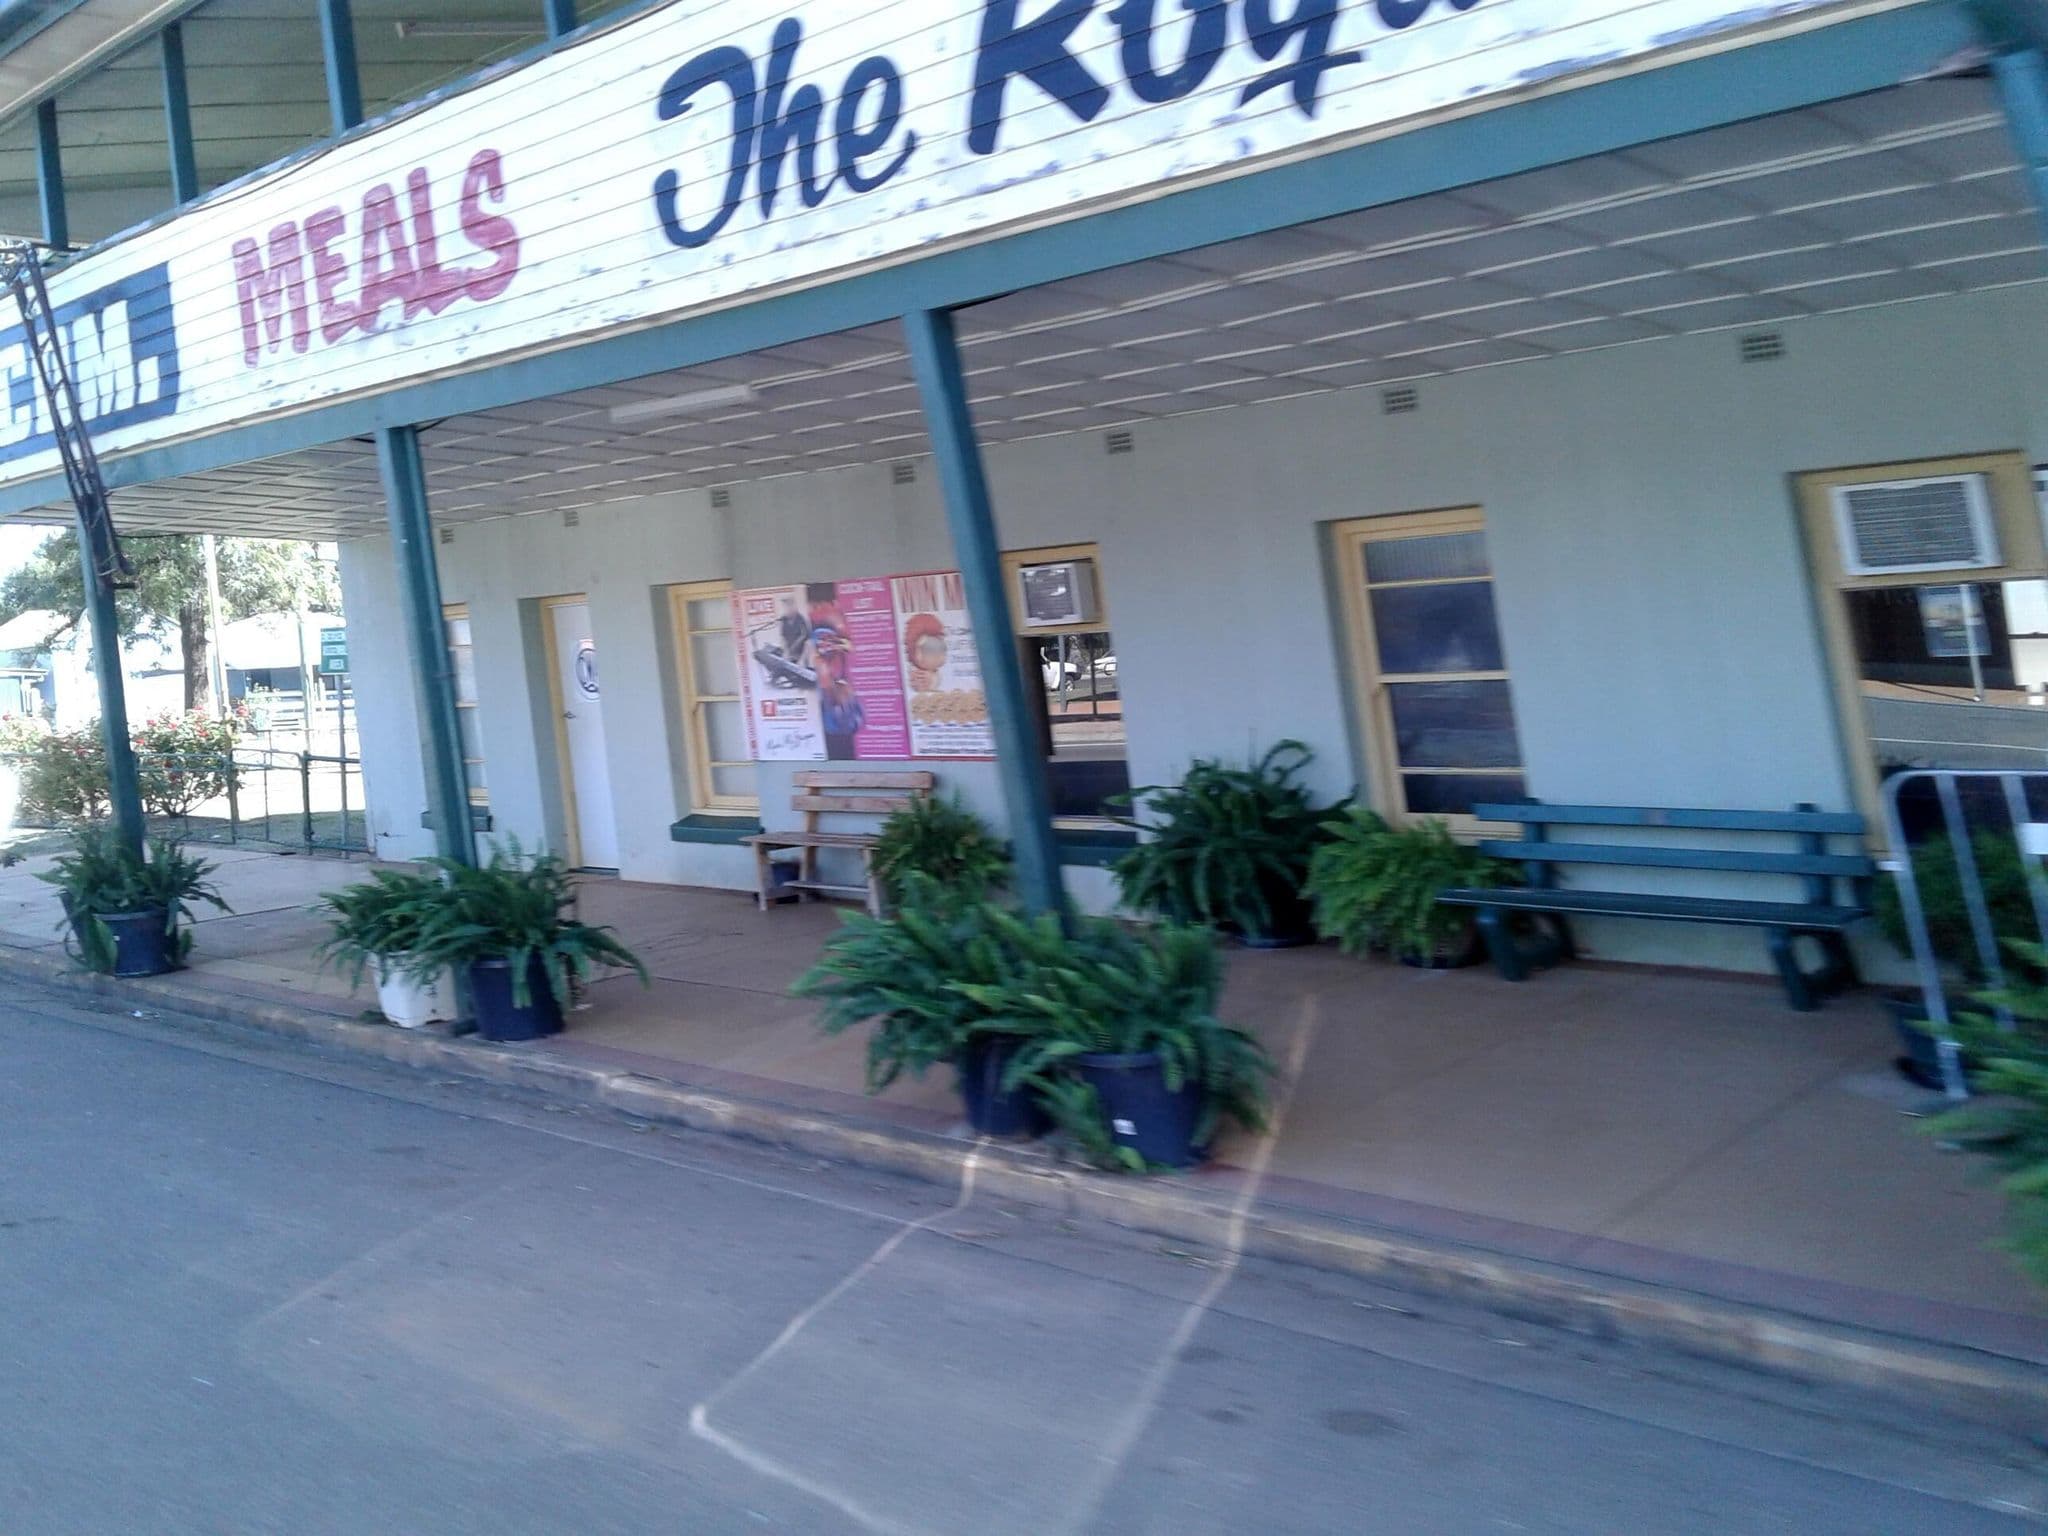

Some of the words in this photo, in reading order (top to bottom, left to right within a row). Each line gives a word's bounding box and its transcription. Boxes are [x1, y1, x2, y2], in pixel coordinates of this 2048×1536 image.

[654, 18, 916, 250] The
[968, 0, 1488, 155] Roy
[232, 148, 520, 368] MEALS
